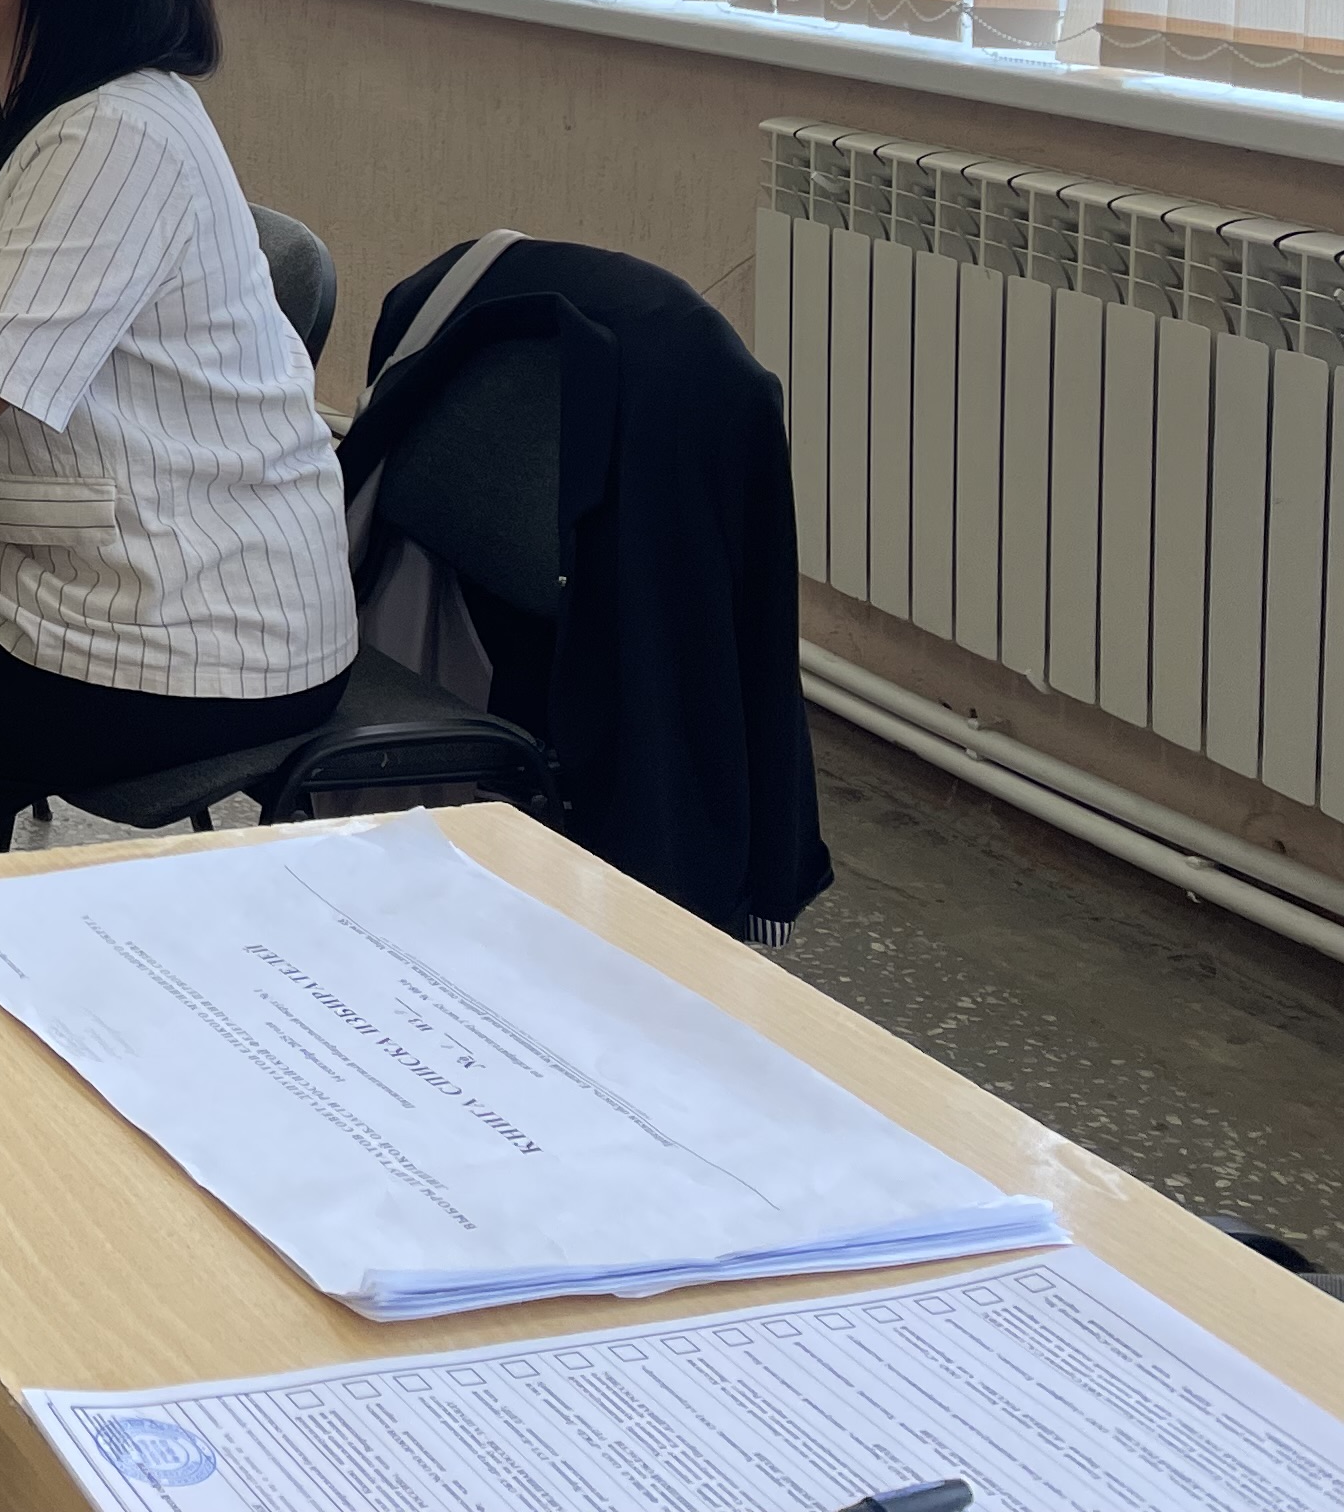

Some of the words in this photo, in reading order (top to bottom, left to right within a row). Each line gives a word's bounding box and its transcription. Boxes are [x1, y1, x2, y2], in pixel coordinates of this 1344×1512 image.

[237, 942, 384, 1036] ИЗБИРАТЕЛЕЙ
[368, 1035, 468, 1097] СПИСКА
[452, 1097, 548, 1155] КНИГА
[416, 1187, 480, 1230] ВЫБОРЫ
